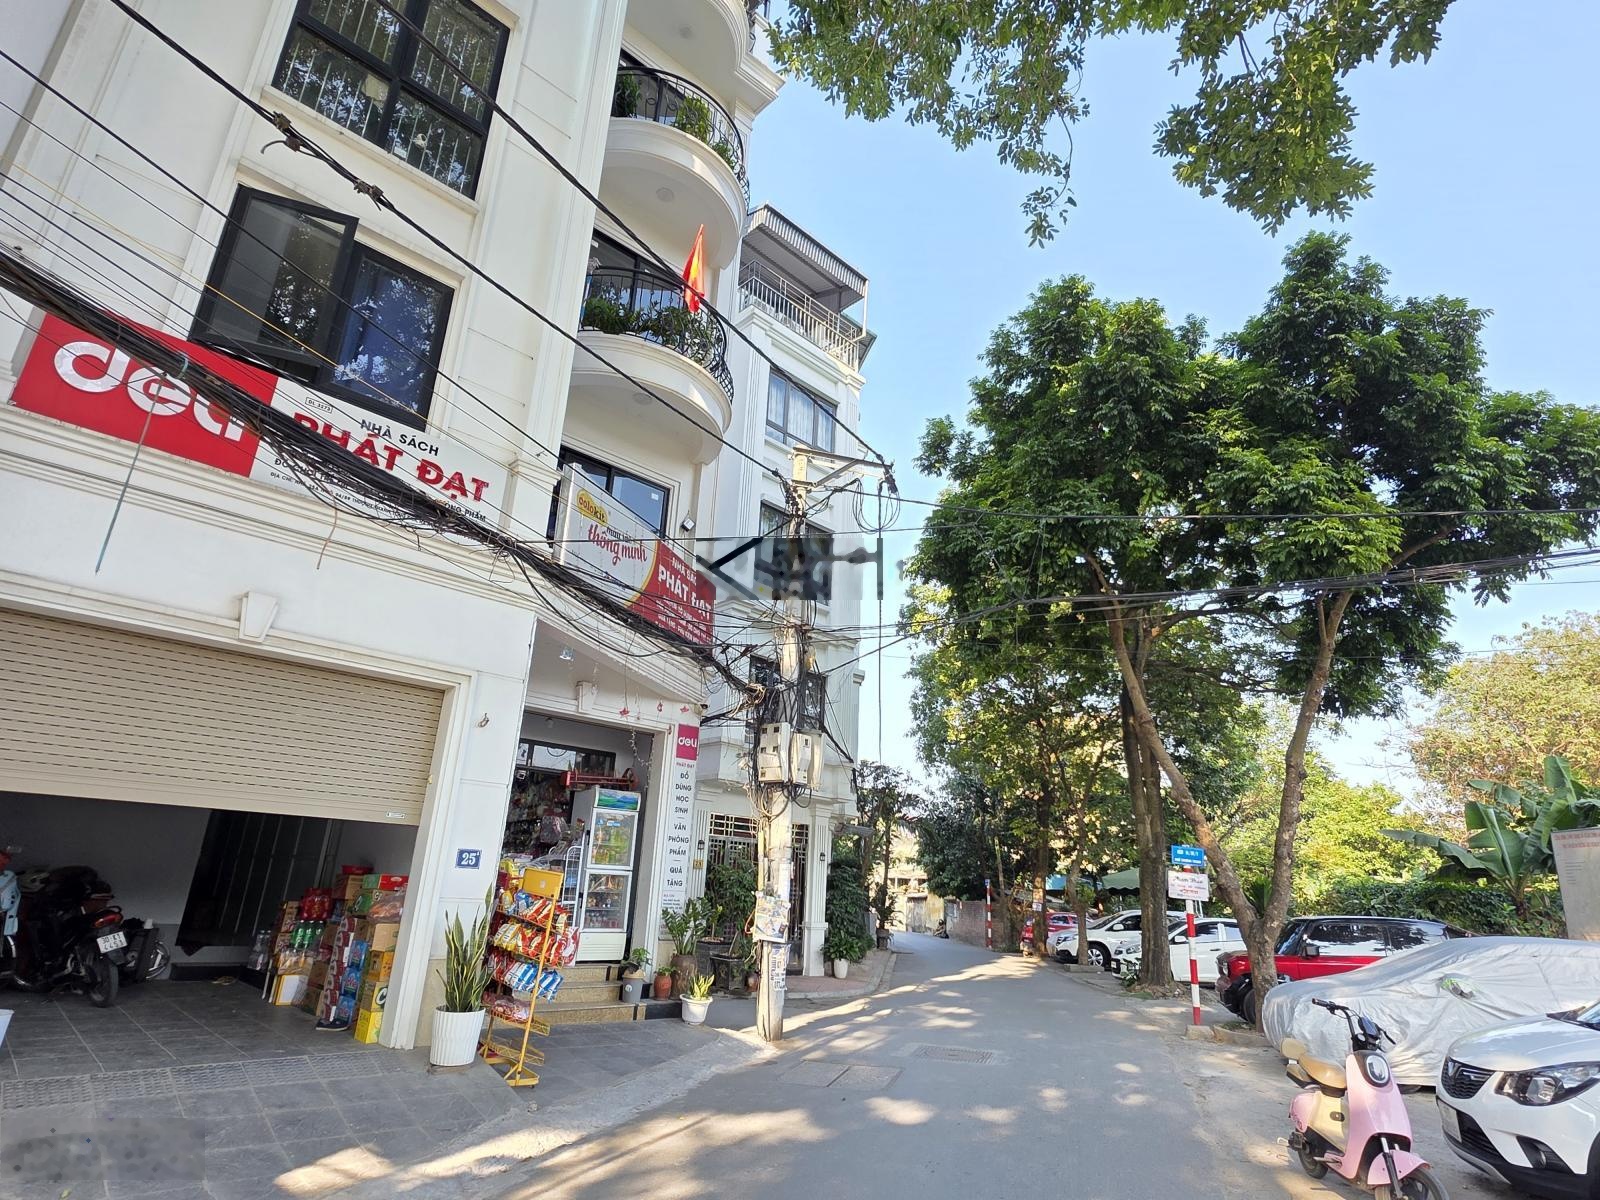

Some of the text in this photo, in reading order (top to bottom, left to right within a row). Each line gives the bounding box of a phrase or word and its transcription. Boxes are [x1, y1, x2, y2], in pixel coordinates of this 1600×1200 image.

[360, 419, 439, 456] NHÀ SÁCH
[416, 458, 489, 502] ĐẠT
[588, 523, 621, 566] thông
[621, 540, 648, 562] minh
[658, 564, 689, 602] PHÁT
[678, 736, 697, 748] deli
[674, 806, 689, 814] SINH
